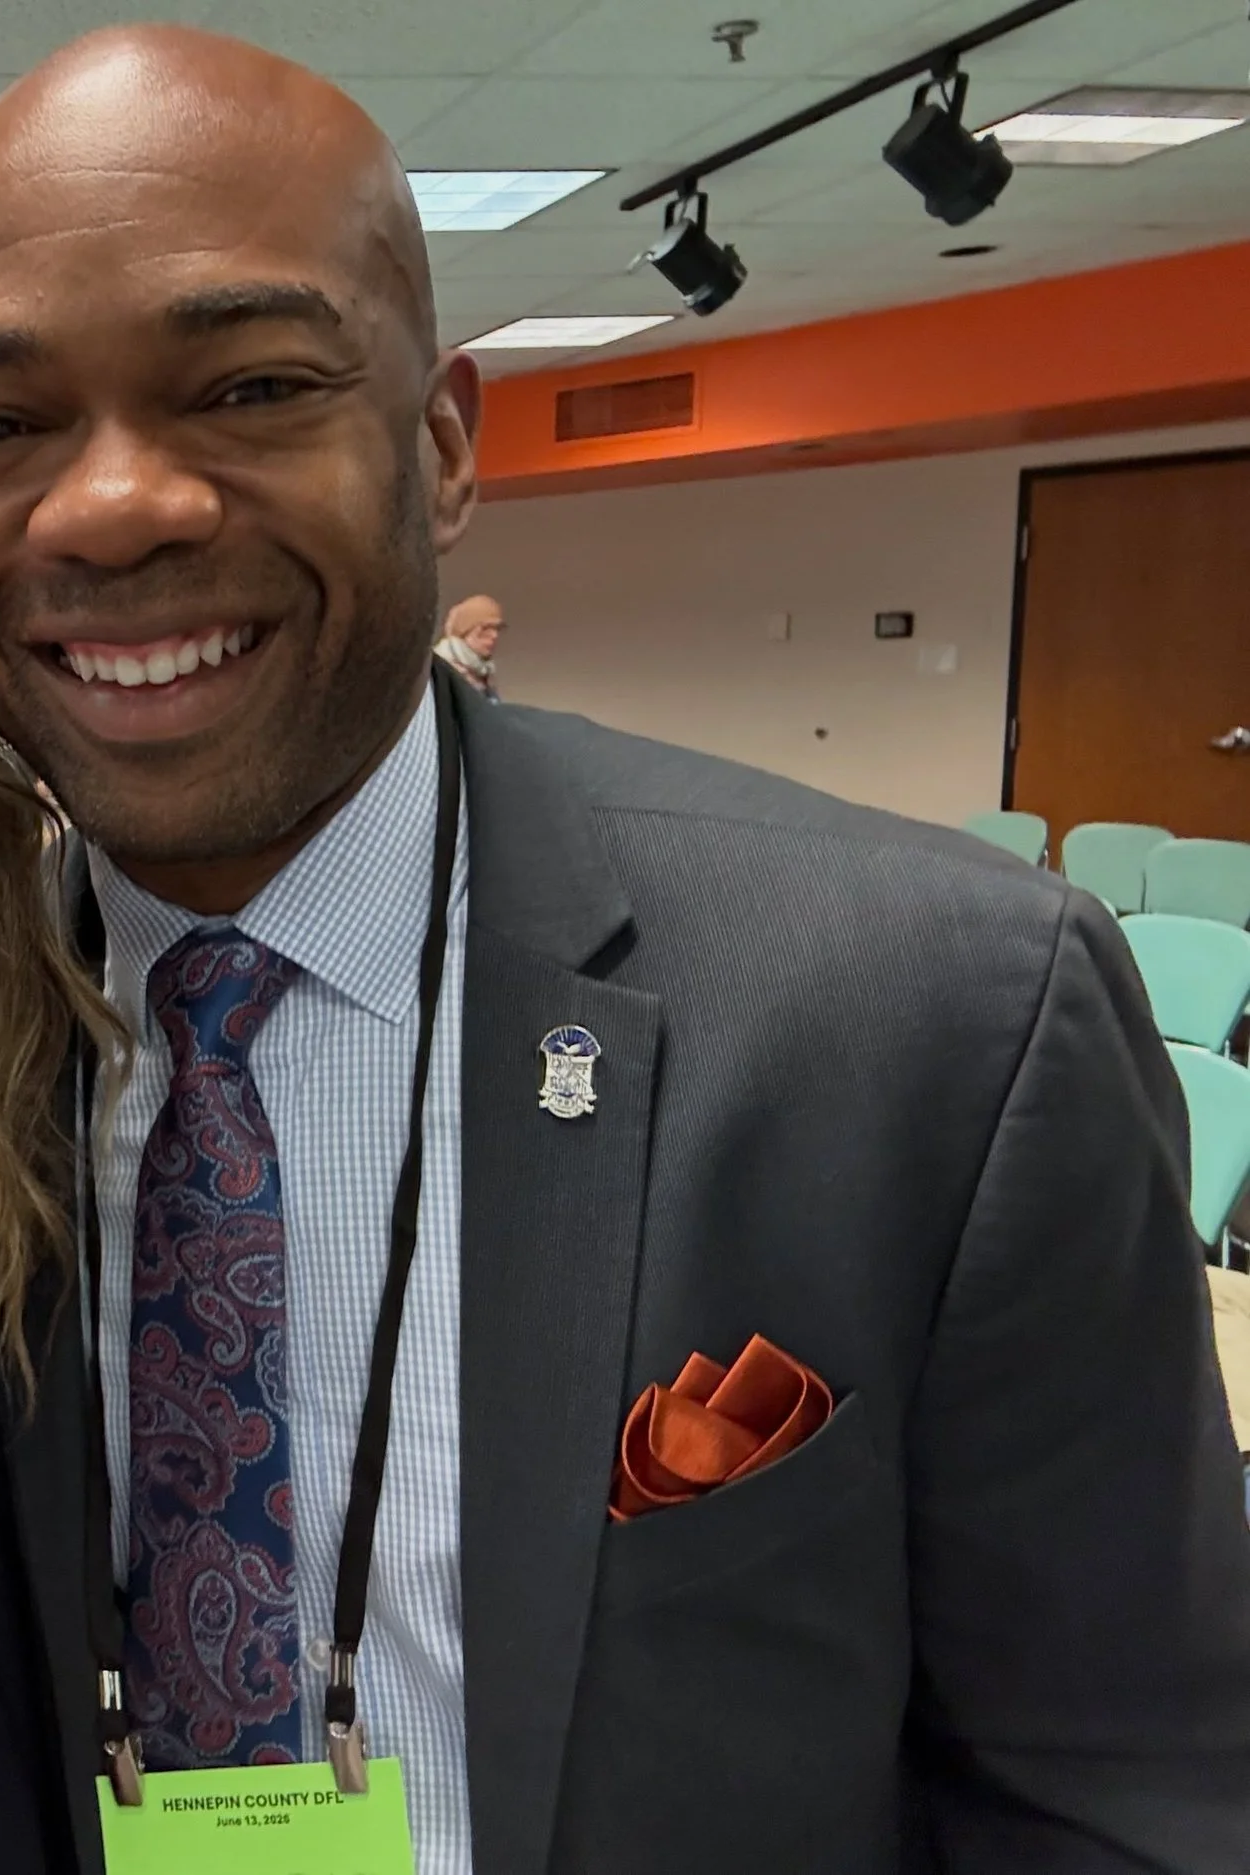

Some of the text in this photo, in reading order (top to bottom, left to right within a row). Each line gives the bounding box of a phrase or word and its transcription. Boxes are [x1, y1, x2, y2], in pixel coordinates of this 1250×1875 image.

[162, 1790, 344, 1812] HENNEPIN COUNTY DFL
[216, 1816, 242, 1827] June
[245, 1814, 262, 1826] 13,
